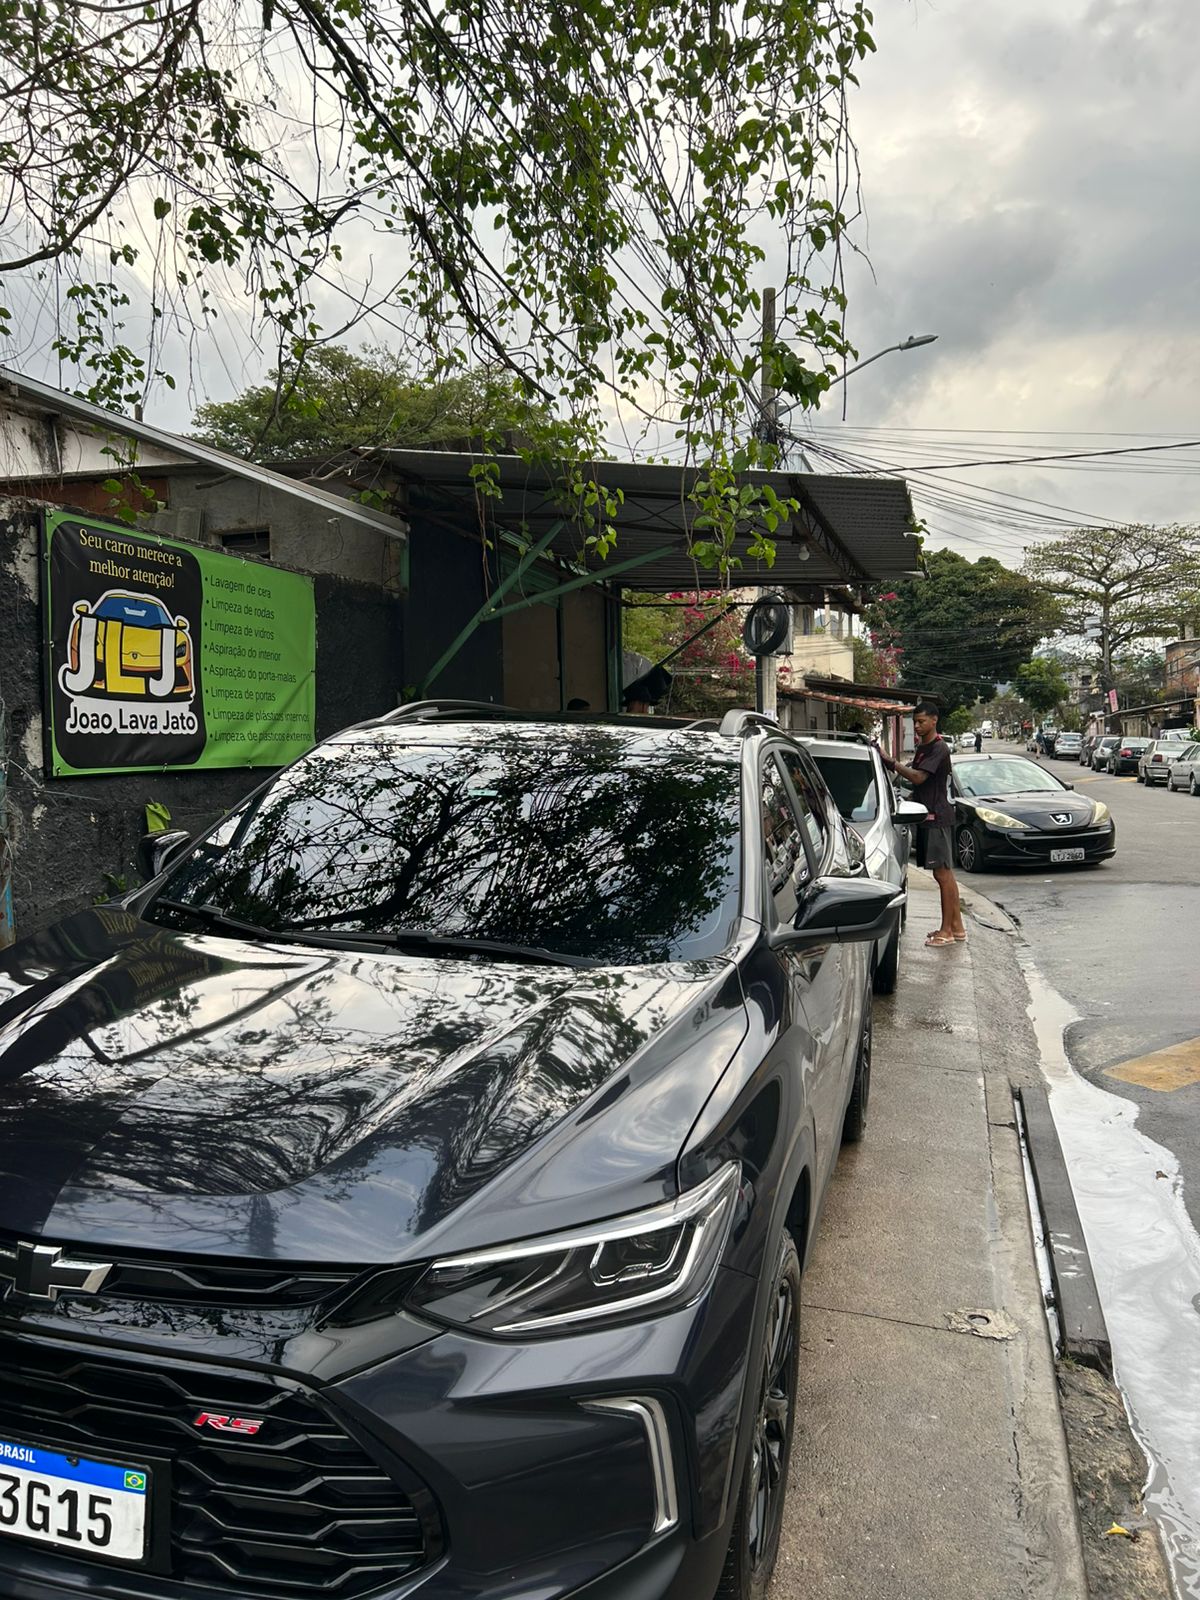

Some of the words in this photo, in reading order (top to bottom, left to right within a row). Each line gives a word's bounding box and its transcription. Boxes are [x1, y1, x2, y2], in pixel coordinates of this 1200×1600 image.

[80, 528, 102, 549] Seu
[105, 539, 134, 556] carro
[137, 546, 174, 565] merece
[176, 556, 182, 567] a
[90, 560, 130, 580] melhor
[132, 568, 174, 588] atenção!
[210, 575, 244, 593] Lavagem
[246, 584, 256, 594] de
[258, 588, 272, 598] cera
[212, 598, 242, 614] Limpeza
[244, 605, 252, 615] de
[255, 608, 274, 620] rodas
[210, 620, 242, 636] Limpeza
[244, 626, 253, 636] de
[255, 629, 274, 640] vidros
[209, 642, 246, 657] Aspiração
[248, 648, 256, 658] do
[259, 651, 281, 661] interior
[209, 664, 246, 680] Aspiração
[248, 668, 256, 679] do
[258, 671, 297, 684] porta-malas
[211, 687, 242, 701] Limpeza
[244, 688, 254, 699] de
[256, 691, 276, 702] portas
[70, 706, 112, 729] Joao
[119, 708, 158, 730] Lava
[162, 710, 196, 730] Jato
[213, 708, 244, 722] Limpeza
[246, 710, 254, 720] de
[214, 732, 246, 744] Limpeza
[247, 731, 258, 742] de
[194, 1412, 264, 1435] RS
